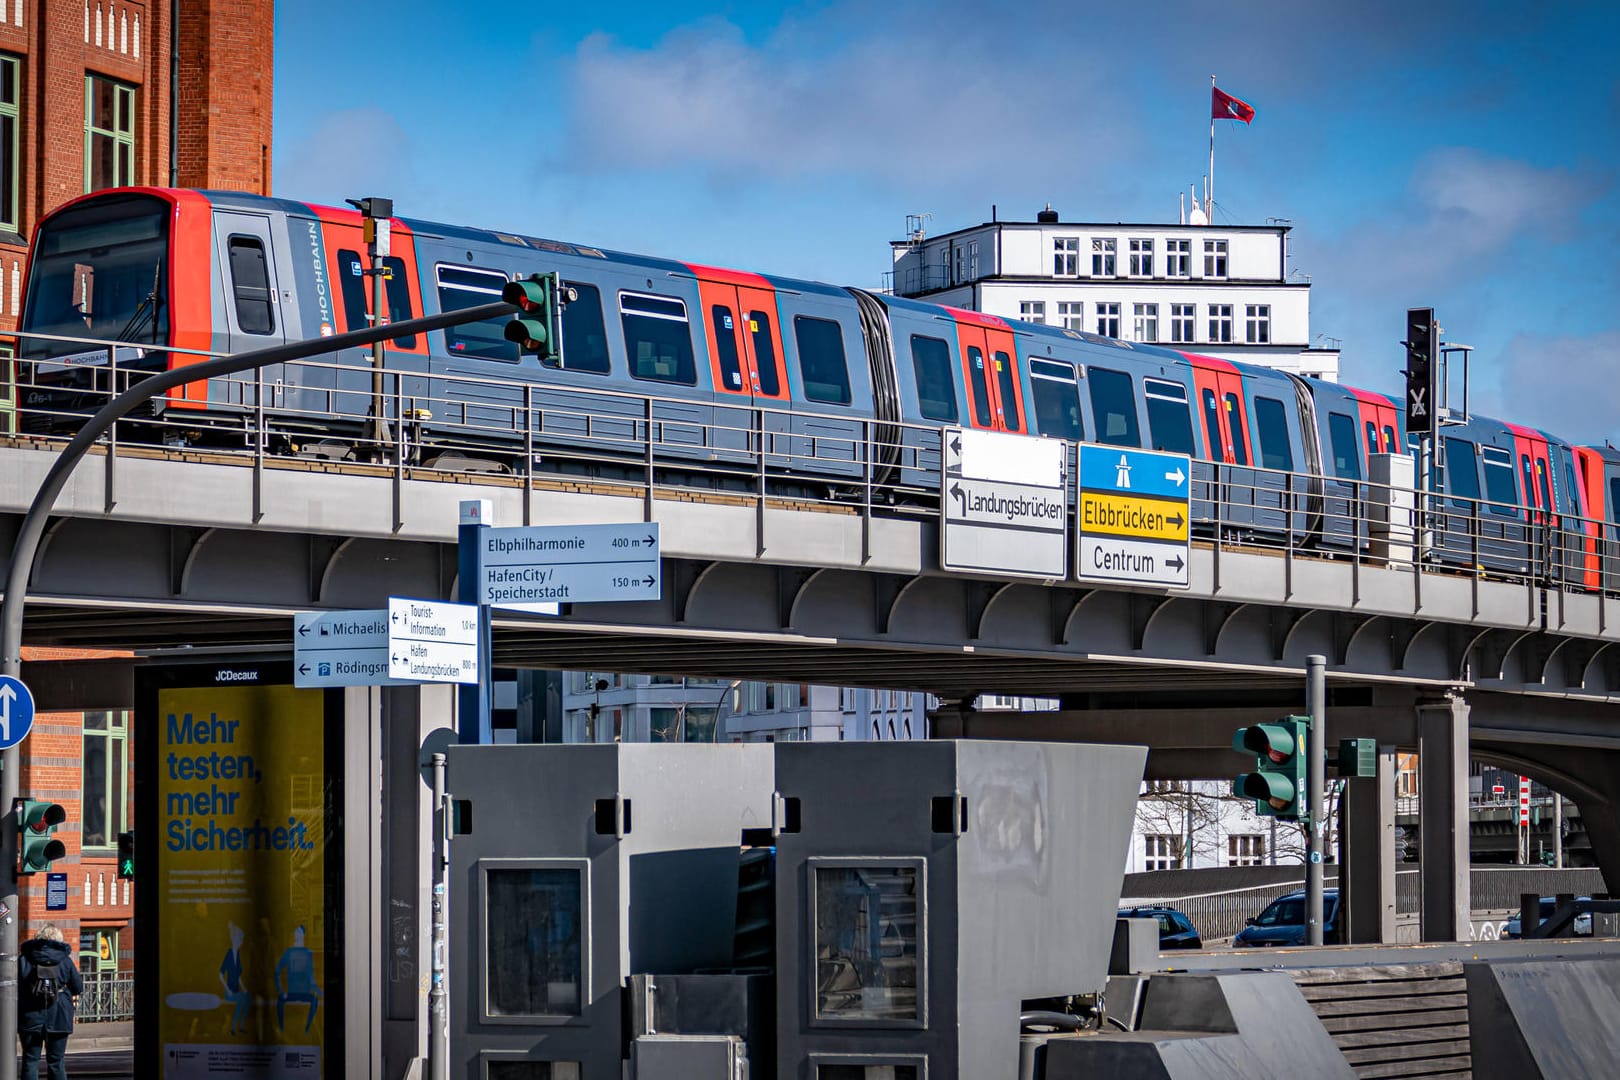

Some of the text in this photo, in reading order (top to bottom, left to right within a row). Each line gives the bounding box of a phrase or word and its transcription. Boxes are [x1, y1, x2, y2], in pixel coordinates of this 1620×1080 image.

[308, 222, 329, 322] HOCHBAHN
[968, 489, 1063, 521] Landungsbrücken
[1084, 500, 1163, 531] Elbbrücken
[488, 536, 640, 554] Elbphilharmonie 400 m
[1094, 545, 1155, 573] Centrum
[488, 568, 546, 584] HafenCity
[612, 577, 629, 587] 150
[488, 584, 569, 601] Speicherstadt
[411, 604, 433, 618] Tourist-
[333, 621, 389, 635] Michaelis
[410, 621, 446, 636] Information
[410, 644, 428, 657] Hafen
[215, 670, 258, 681] JCDecaux
[410, 662, 460, 678] Landungsbrücken
[167, 712, 240, 744] Mehr
[166, 752, 262, 784] testen,
[167, 784, 240, 816] mehr
[166, 816, 314, 851] Sicherheit.
